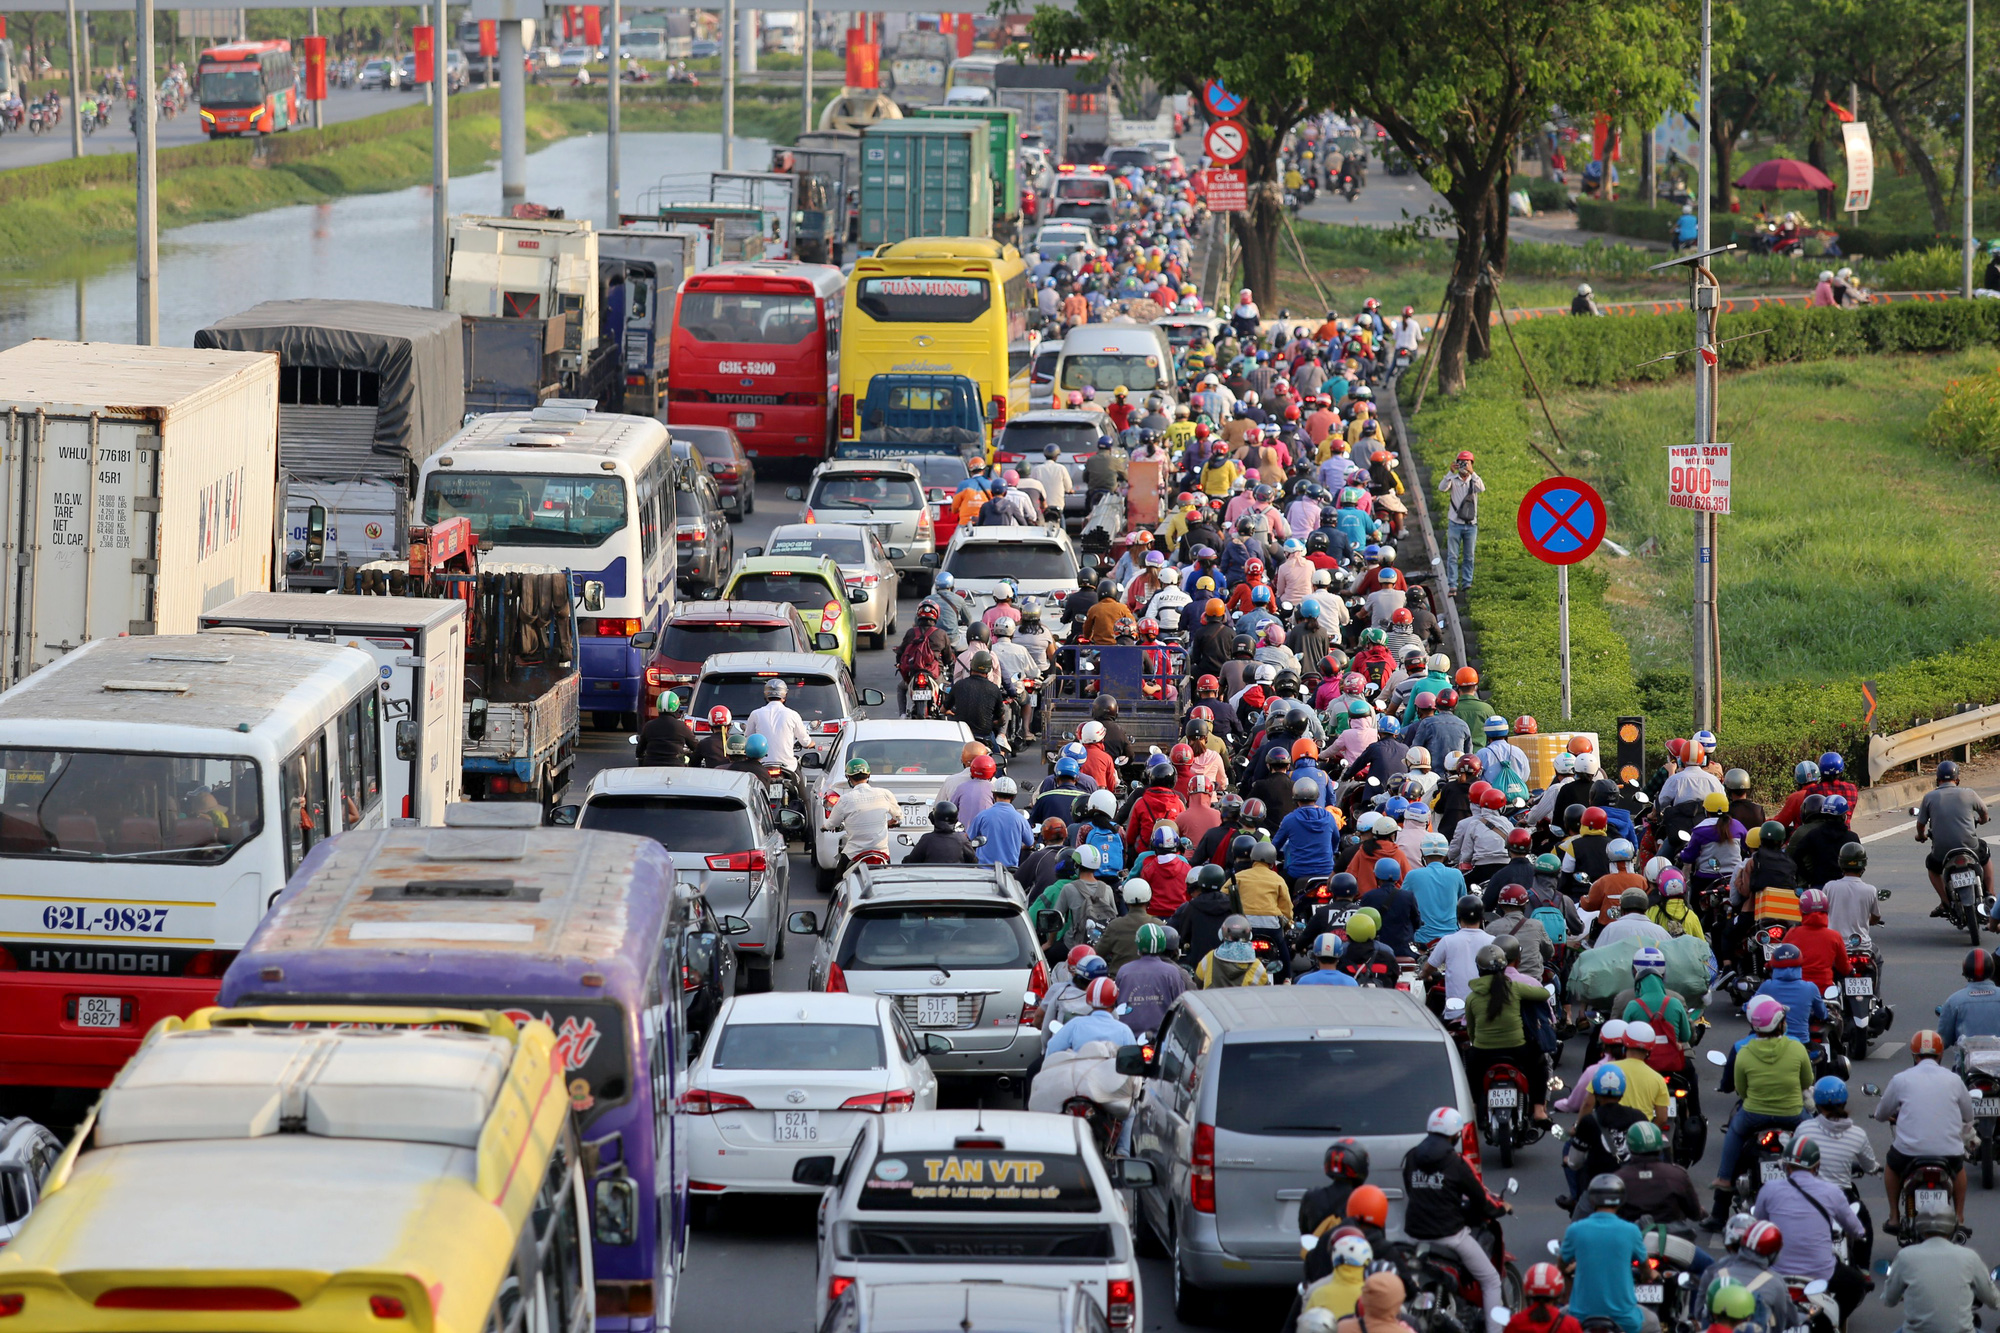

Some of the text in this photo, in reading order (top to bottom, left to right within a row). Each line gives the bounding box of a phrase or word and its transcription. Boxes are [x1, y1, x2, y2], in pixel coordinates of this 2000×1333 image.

[718, 361, 776, 375] 63K-5200
[716, 394, 777, 405] HYUNDAI
[58, 446, 147, 464] WHLU 776181 0
[1671, 445, 1728, 457] NHÀ BÁN
[98, 471, 121, 485] 45R1
[1671, 466, 1729, 495] 900 Triệu
[54, 493, 83, 506] M.G.W.
[1670, 494, 1729, 512] 0908.626.351
[54, 506, 74, 519] TARE
[53, 519, 68, 532] NET
[52, 533, 84, 546] CU. CAP.
[904, 805, 920, 816] 51F
[904, 816, 928, 826] 14.66
[43, 905, 170, 932] 62L-9827
[30, 950, 170, 972] HYUNDAI
[87, 999, 112, 1013] 62L
[927, 998, 949, 1011] 51F
[83, 1012, 116, 1026] 9827
[919, 1011, 957, 1024] 217.33
[785, 1112, 808, 1126] 62A
[778, 1126, 817, 1140] 134.16
[924, 1154, 1045, 1183] TÂN VTP
